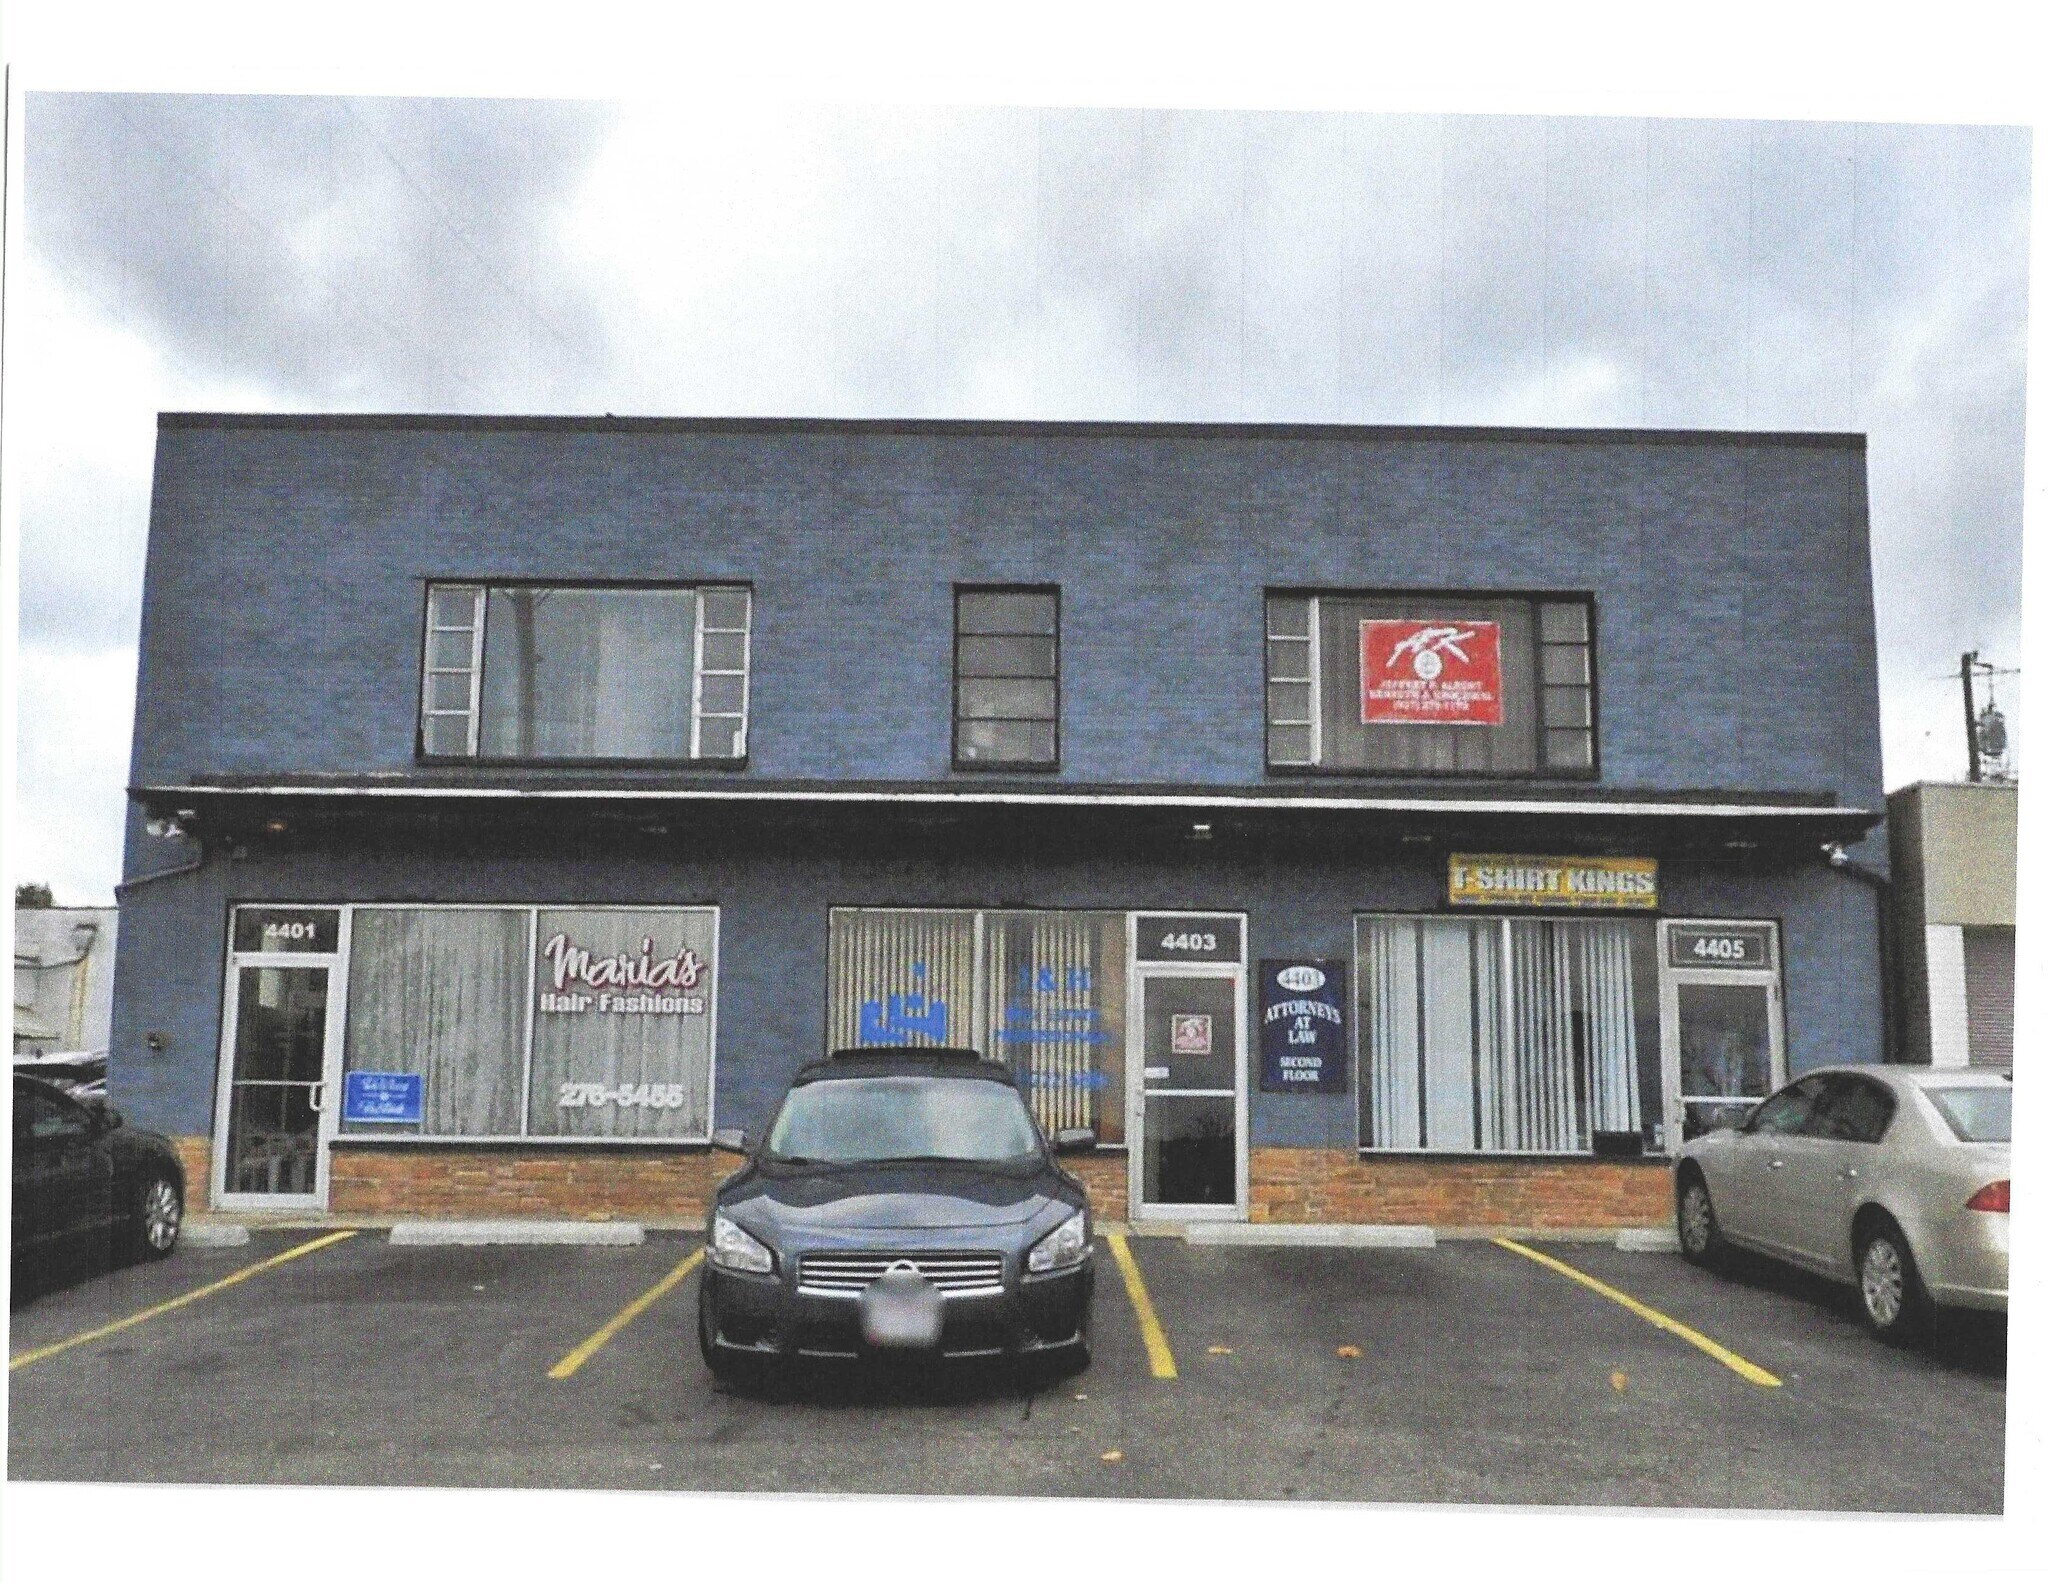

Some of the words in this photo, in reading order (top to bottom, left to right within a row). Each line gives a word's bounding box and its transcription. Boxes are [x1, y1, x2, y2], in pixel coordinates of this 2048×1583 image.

[1452, 866, 1562, 891] T-SHIRT
[1566, 869, 1656, 894] KINGS
[264, 923, 316, 939] 4401
[1161, 932, 1216, 951] 4403
[1693, 938, 1745, 959] 4405
[544, 934, 704, 990] Maria's
[540, 993, 592, 1012] Hair
[599, 994, 703, 1013] Fashions
[1264, 1000, 1342, 1025] ATTORNEYS
[1294, 1016, 1312, 1030] AT
[1288, 1030, 1317, 1044] LAW
[1280, 1056, 1322, 1068] SECOND
[1282, 1070, 1320, 1082] FLOOR
